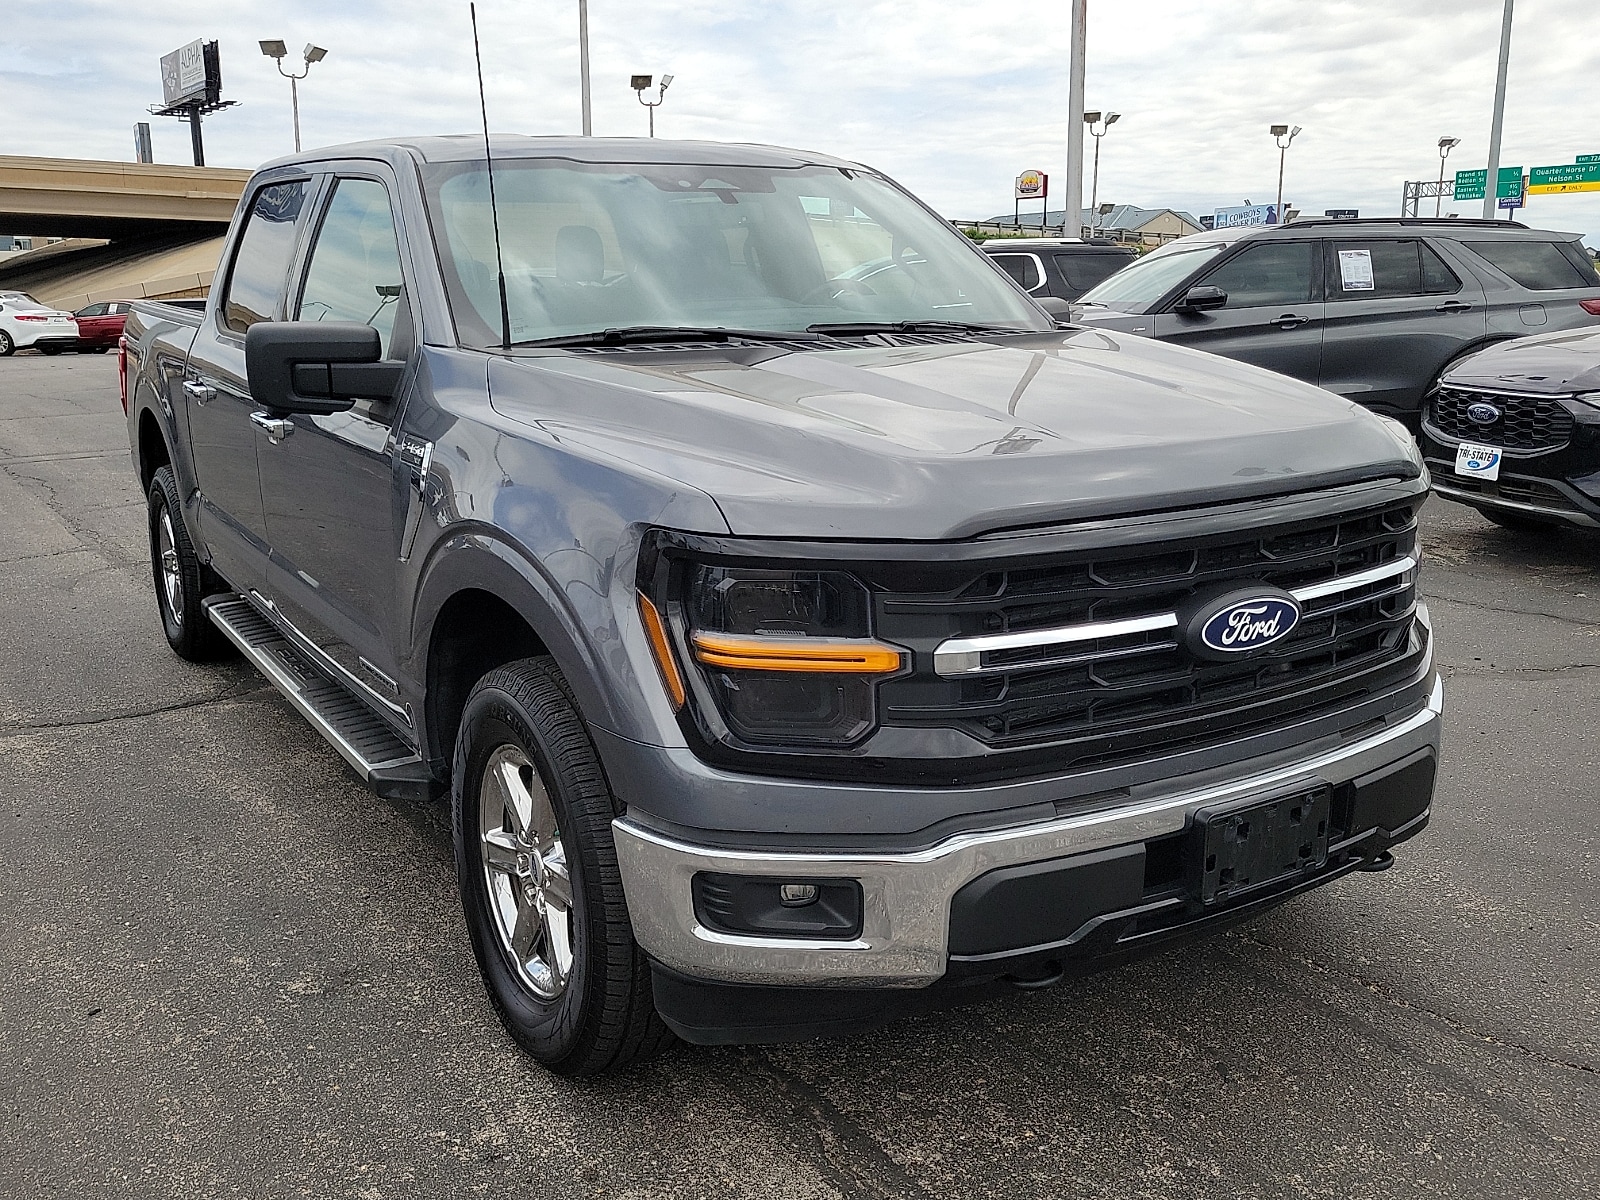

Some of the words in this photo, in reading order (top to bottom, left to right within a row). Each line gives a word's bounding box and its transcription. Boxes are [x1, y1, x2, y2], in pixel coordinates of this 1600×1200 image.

[181, 43, 201, 69] ALPHA
[1536, 168, 1562, 176] Quarter
[1229, 208, 1261, 223] COWBOYS
[1251, 216, 1261, 225] DIE
[1473, 407, 1490, 420] Ford
[1459, 448, 1493, 462] TRI-STATE
[1221, 605, 1282, 646] Ford
[487, 702, 537, 758] ORTUNE
